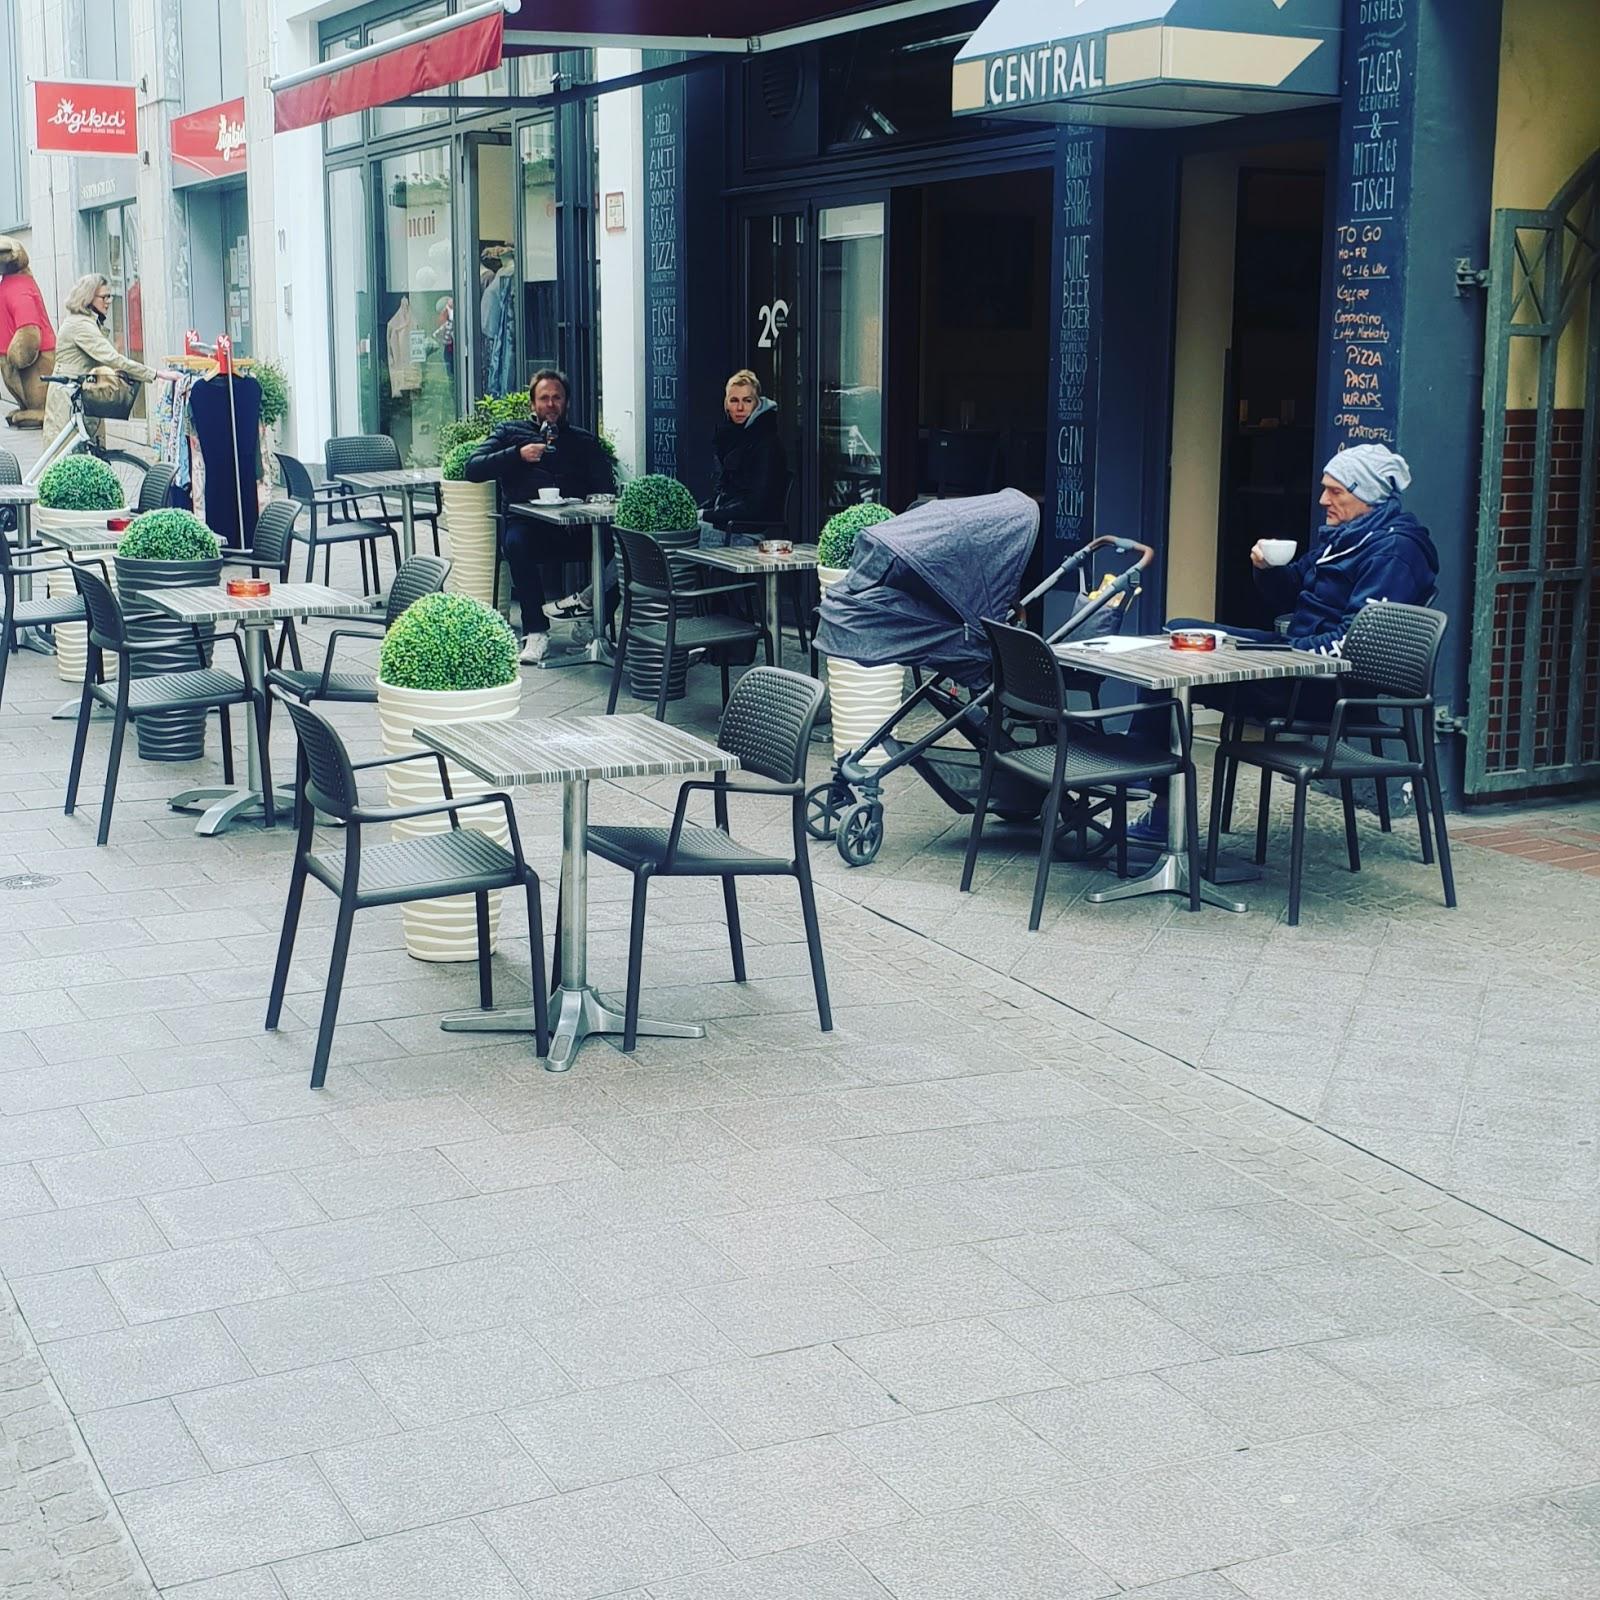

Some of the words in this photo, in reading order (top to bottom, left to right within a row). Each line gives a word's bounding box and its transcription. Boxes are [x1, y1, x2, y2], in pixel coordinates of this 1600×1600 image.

[1360, 0, 1404, 24] DISHES
[988, 39, 1103, 105] CENTRAL
[1358, 49, 1402, 95] TAGES
[47, 98, 126, 134] sigikid
[649, 145, 676, 170] ANTI
[1353, 138, 1397, 176] MITTAGS
[649, 167, 676, 190] PASTI
[651, 187, 675, 207] SOUPS
[1064, 179, 1092, 207] SODA
[1352, 176, 1395, 212] TISCH
[651, 205, 676, 231] PASTA
[1064, 204, 1092, 227] TONIC
[1337, 225, 1357, 245] TO
[1362, 225, 1382, 242] GO
[651, 241, 677, 271] PIZZA
[1063, 235, 1090, 281] WINE
[1063, 279, 1090, 308] BEER
[652, 306, 676, 336] FISH
[1061, 308, 1090, 329] CIDER
[652, 345, 677, 367] STEAK
[653, 376, 678, 400] FILET
[1344, 368, 1379, 390] PASTA
[1342, 392, 1382, 408] WRAPS
[654, 417, 677, 433] BREAK
[1334, 414, 1360, 427] OFEN
[654, 433, 677, 453] FAST
[1057, 425, 1084, 465] GIN
[1348, 426, 1395, 443] KARTOFFEL
[1057, 490, 1084, 517] RUM
